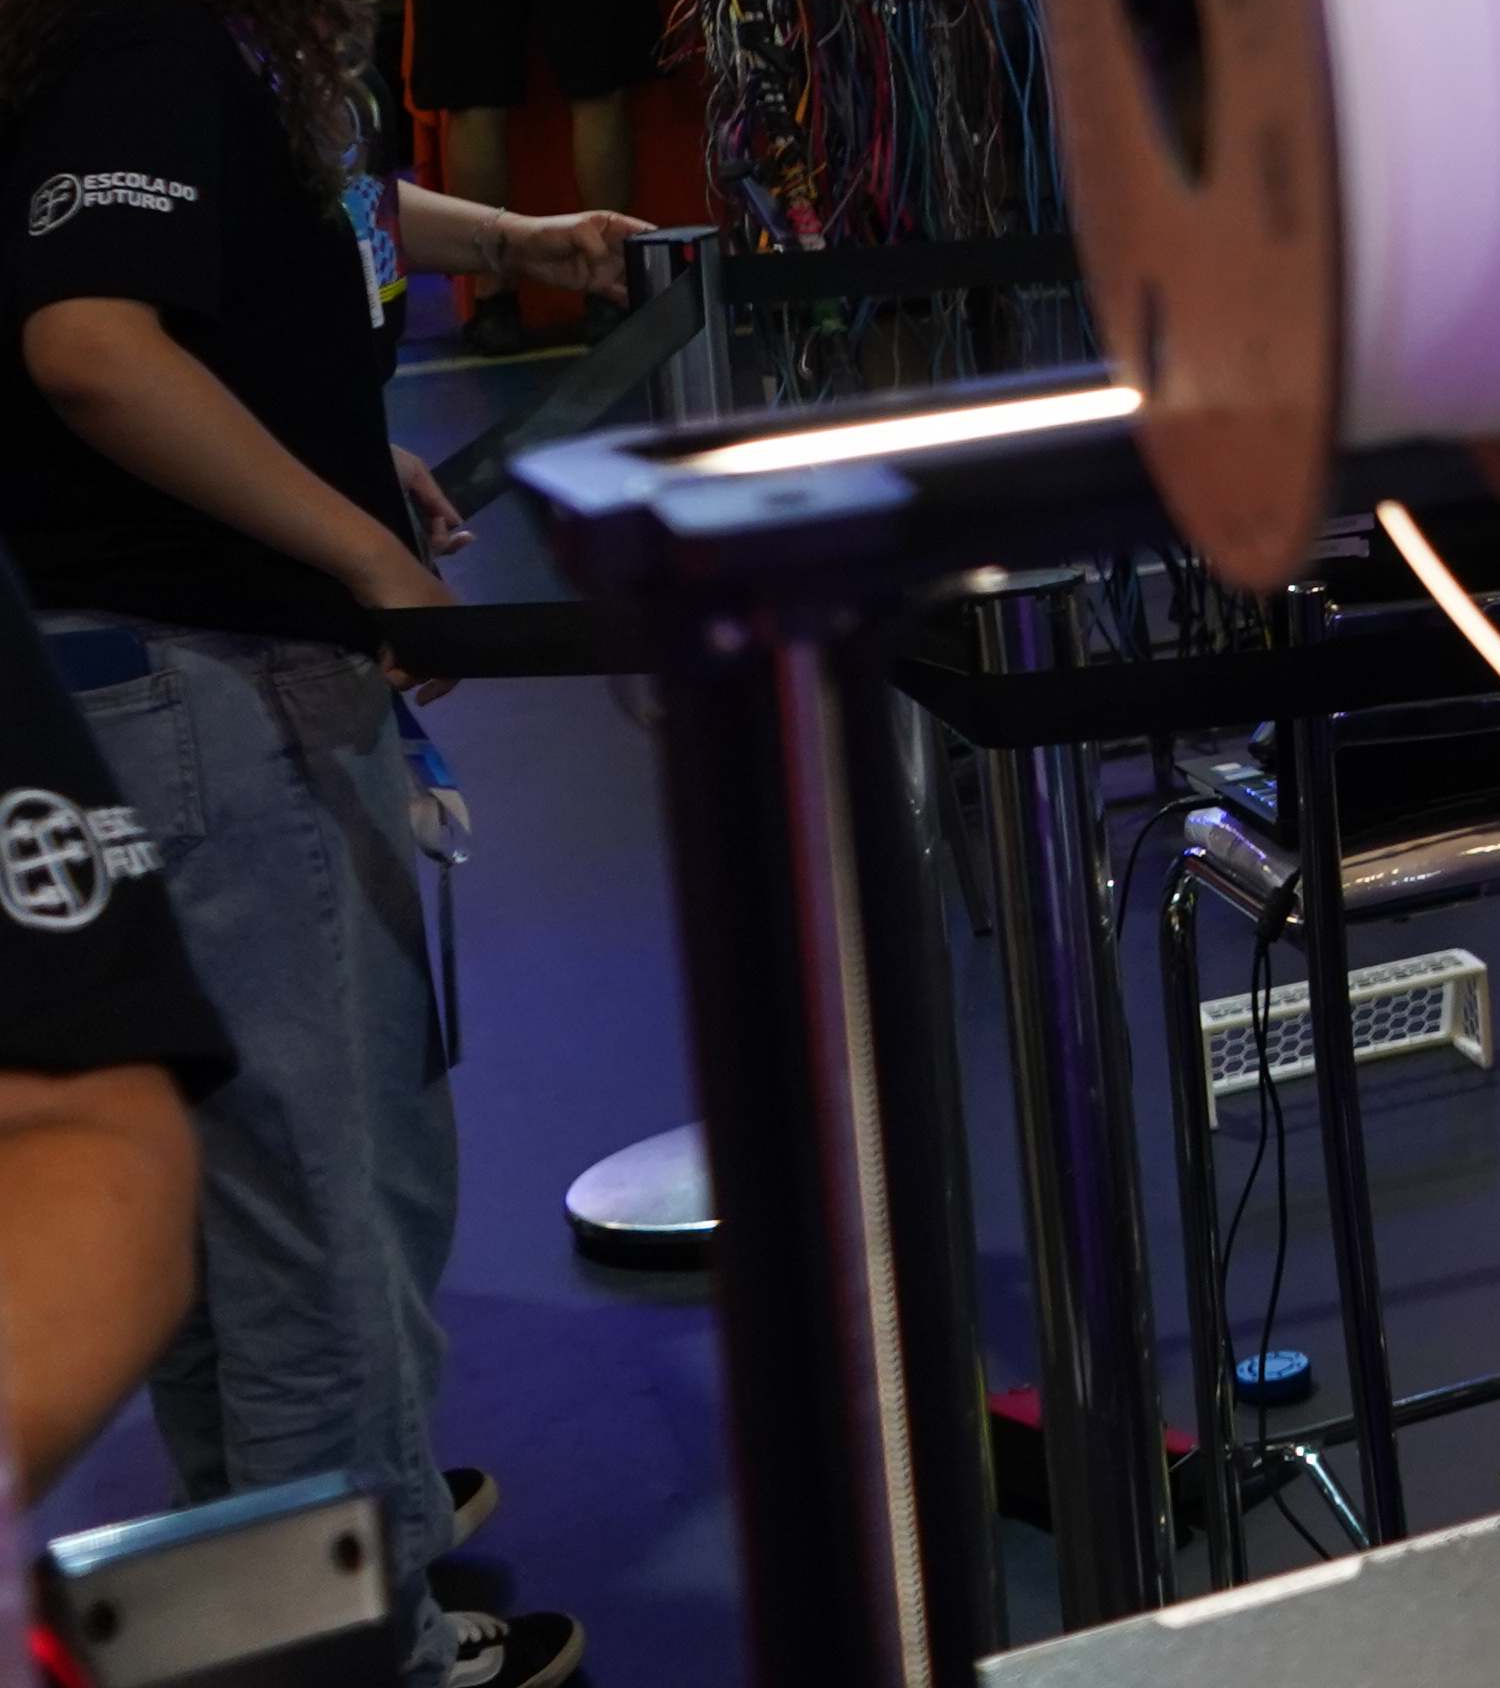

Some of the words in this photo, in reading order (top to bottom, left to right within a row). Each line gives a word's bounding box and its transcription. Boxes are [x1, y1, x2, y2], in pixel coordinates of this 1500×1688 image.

[83, 171, 167, 196] ESCOLA
[168, 180, 199, 204] DO
[83, 187, 174, 213] FUTURO
